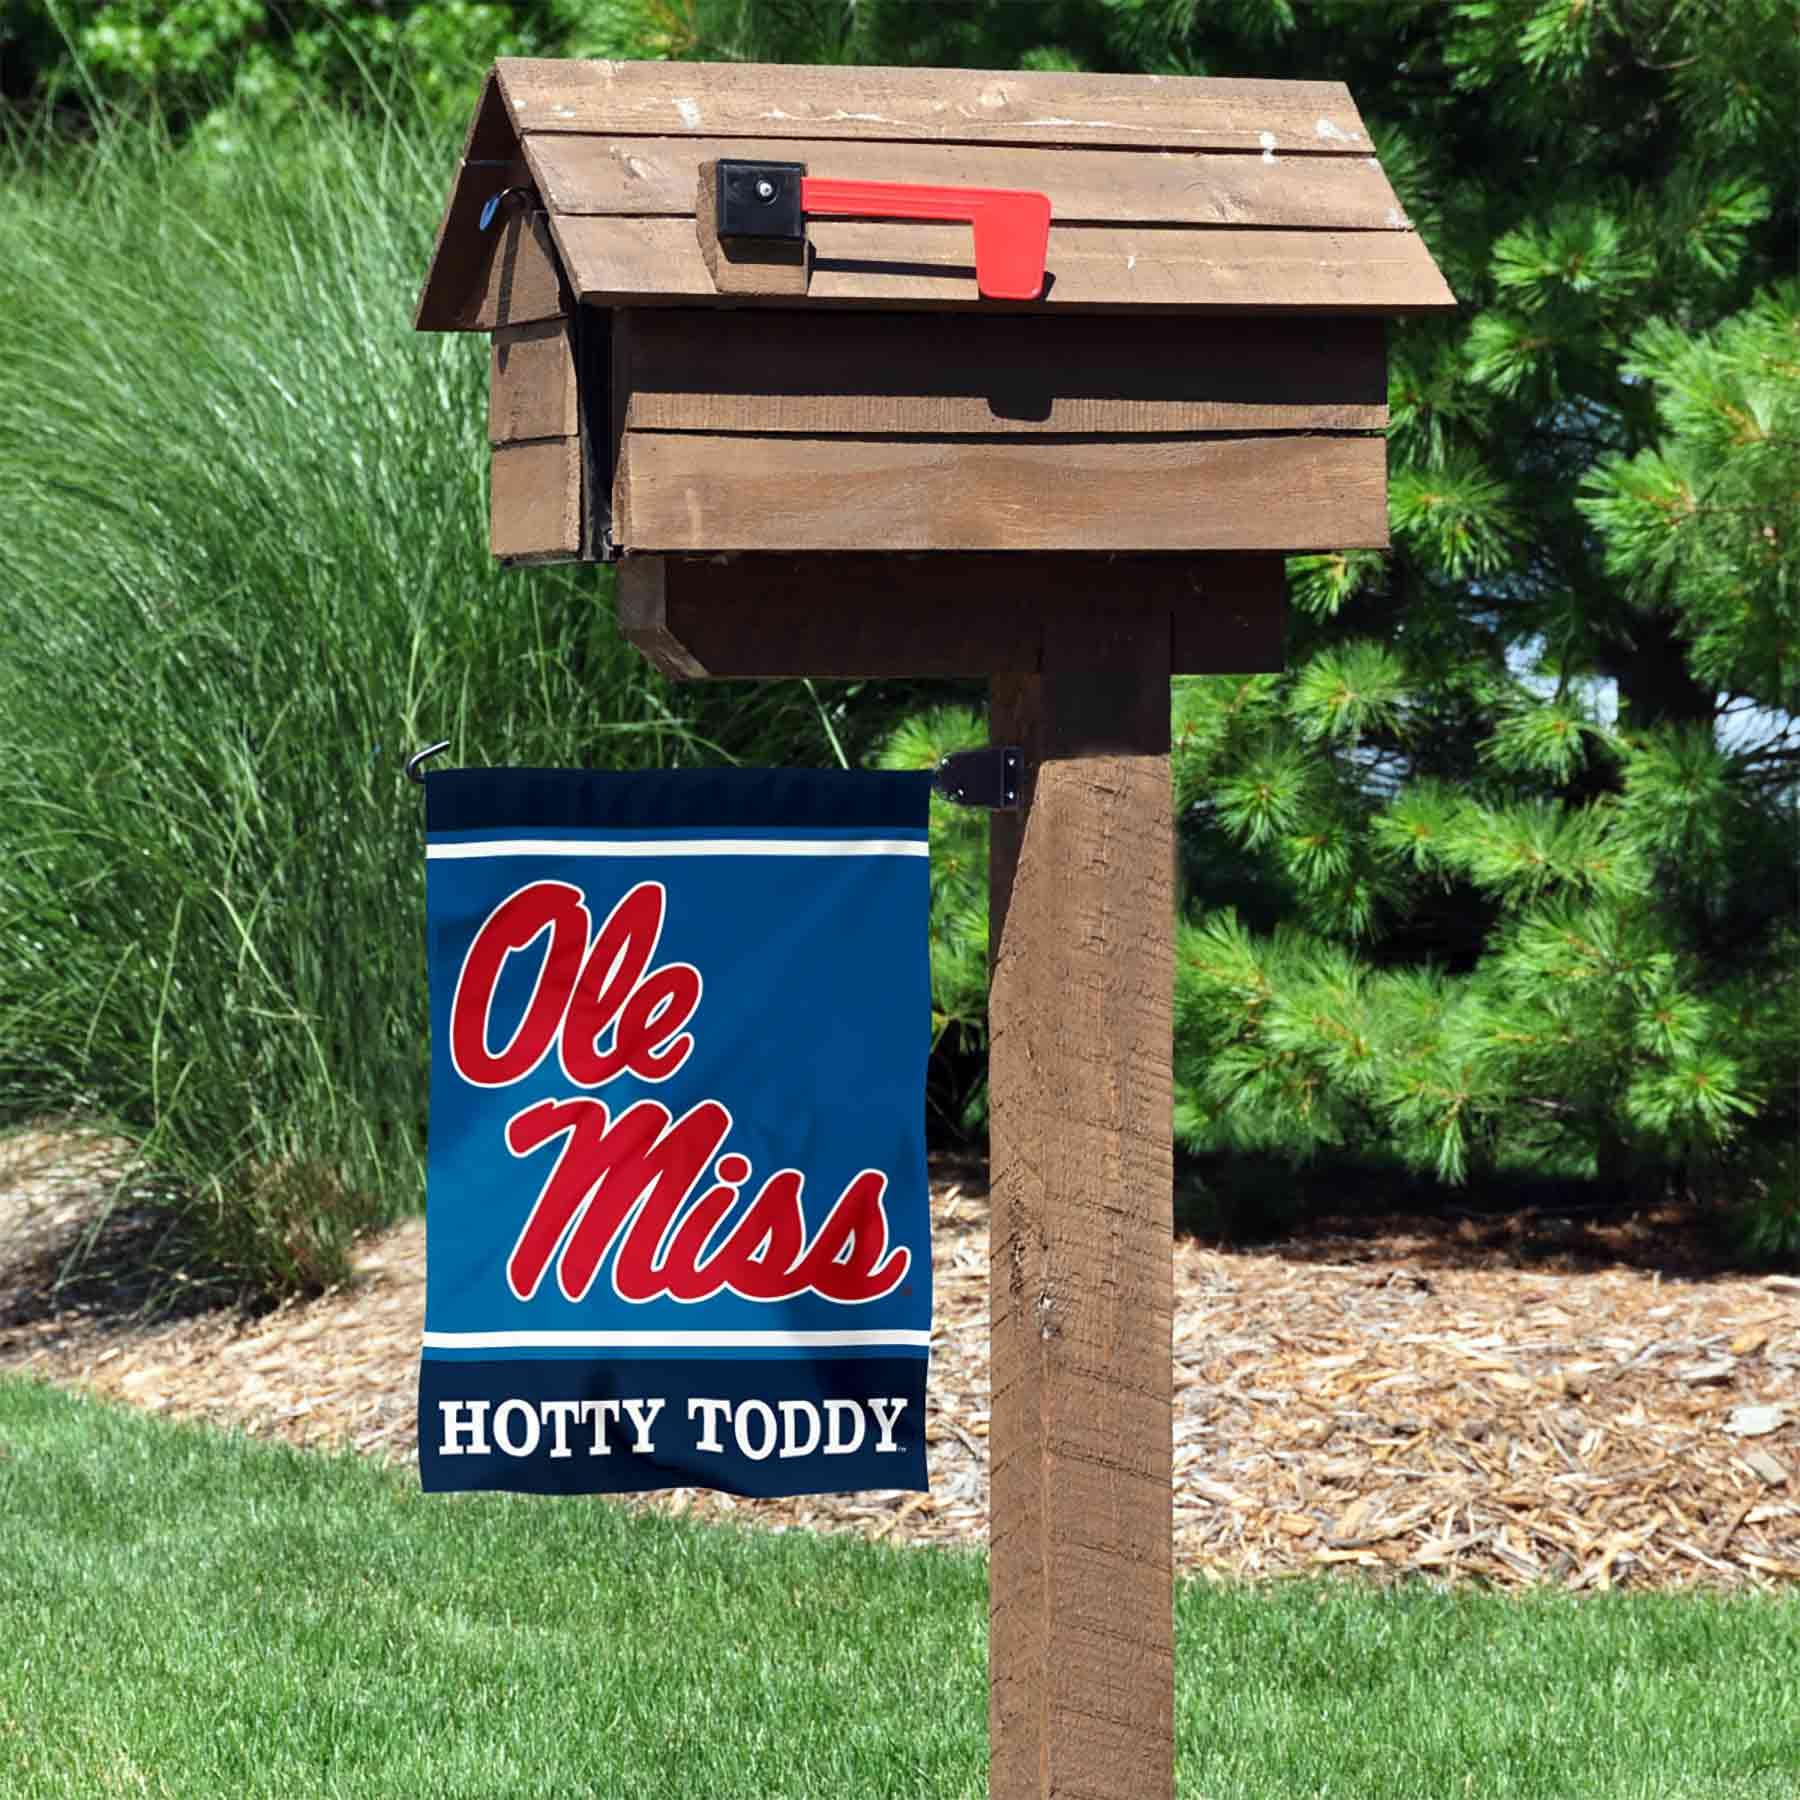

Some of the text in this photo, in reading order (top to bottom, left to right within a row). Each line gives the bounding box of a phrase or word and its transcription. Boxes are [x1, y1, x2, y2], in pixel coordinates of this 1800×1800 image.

[450, 881, 703, 1088] Ole
[504, 1098, 912, 1304] Miss
[438, 1397, 909, 1460] HOTTY TODDY
